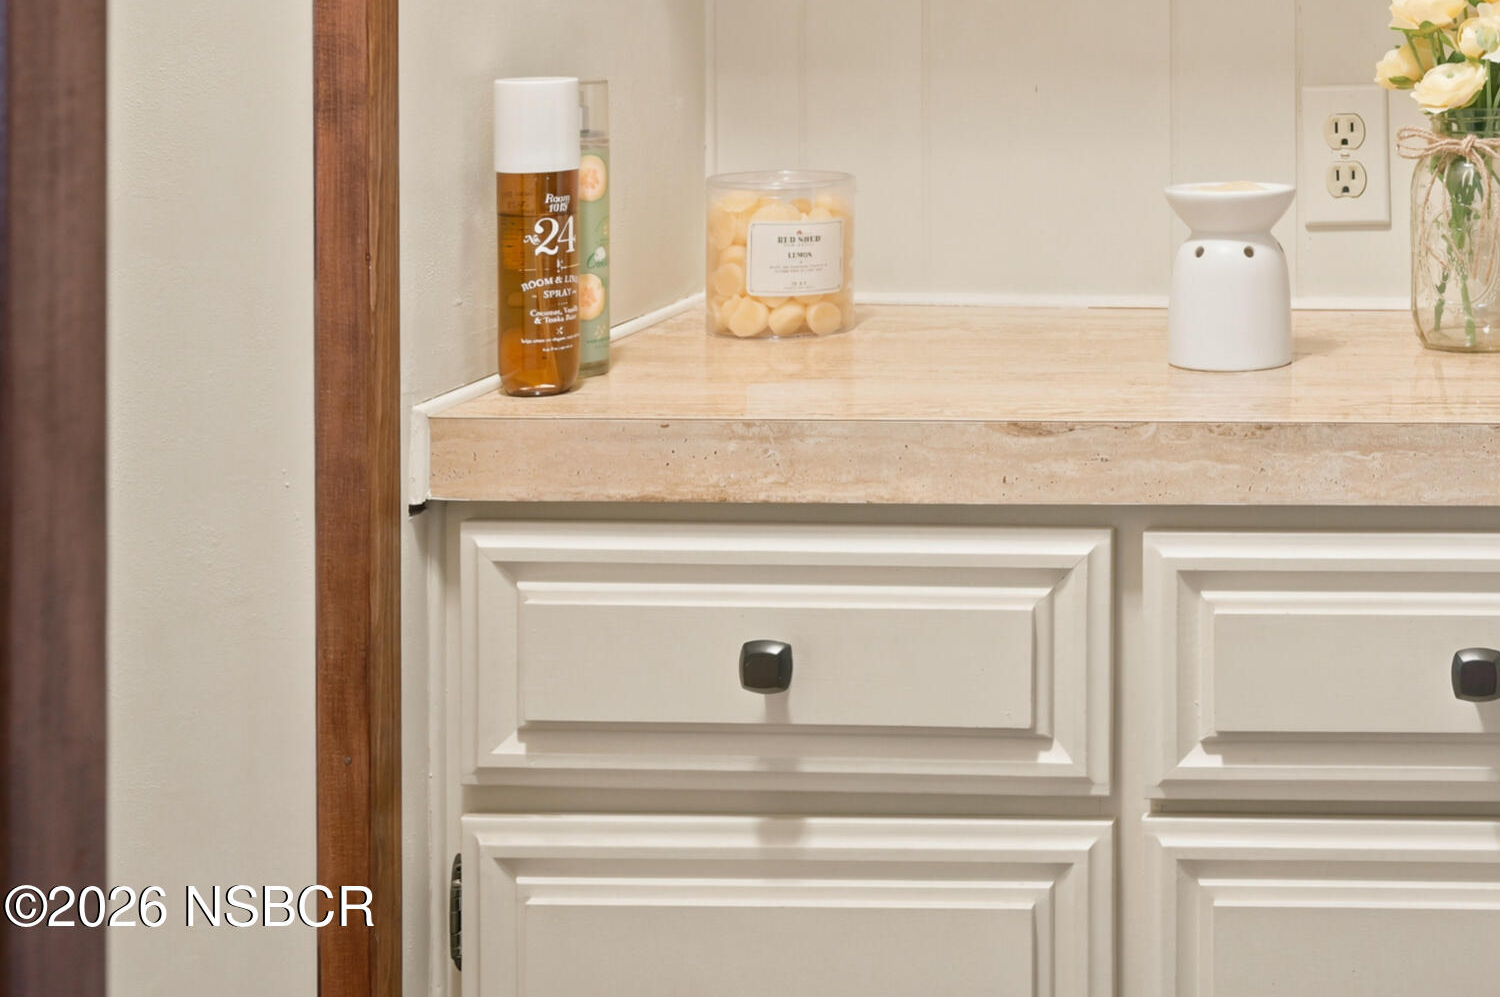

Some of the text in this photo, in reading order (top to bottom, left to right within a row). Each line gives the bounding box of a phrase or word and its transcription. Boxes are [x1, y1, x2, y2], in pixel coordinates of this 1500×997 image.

[545, 193, 571, 204] Room
[534, 215, 577, 256] 24
[521, 276, 554, 292] ROOM
[554, 275, 563, 284] &
[543, 288, 571, 299] SPRAY
